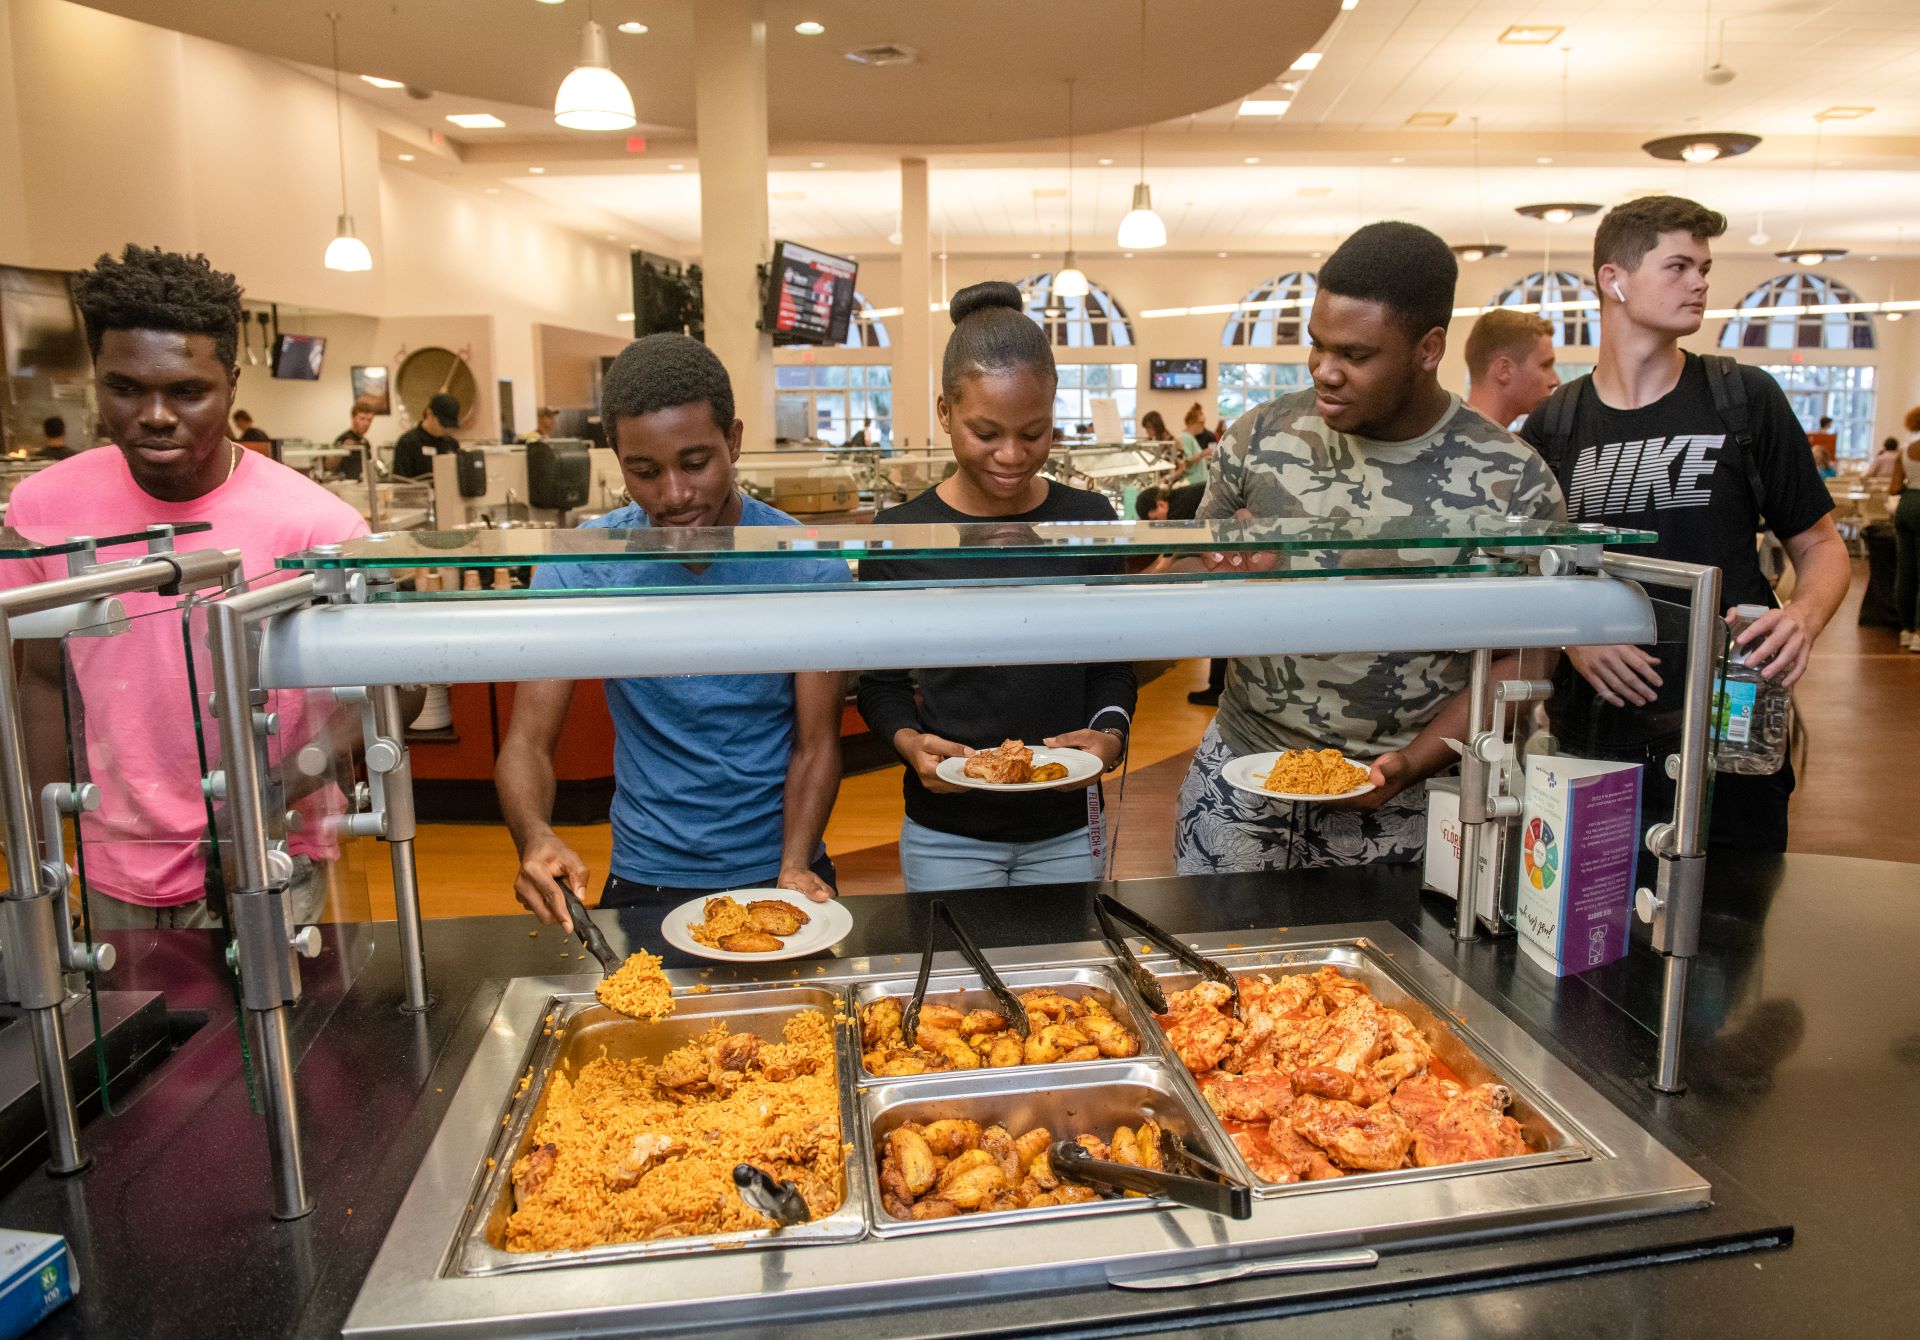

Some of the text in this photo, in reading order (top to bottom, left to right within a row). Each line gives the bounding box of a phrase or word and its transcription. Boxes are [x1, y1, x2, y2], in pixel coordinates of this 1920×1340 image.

[1567, 434, 1727, 520] NIKE
[1088, 792, 1101, 846] FLORIDA TECH
[1453, 845, 1461, 860] TE
[42, 1271, 57, 1287] XL
